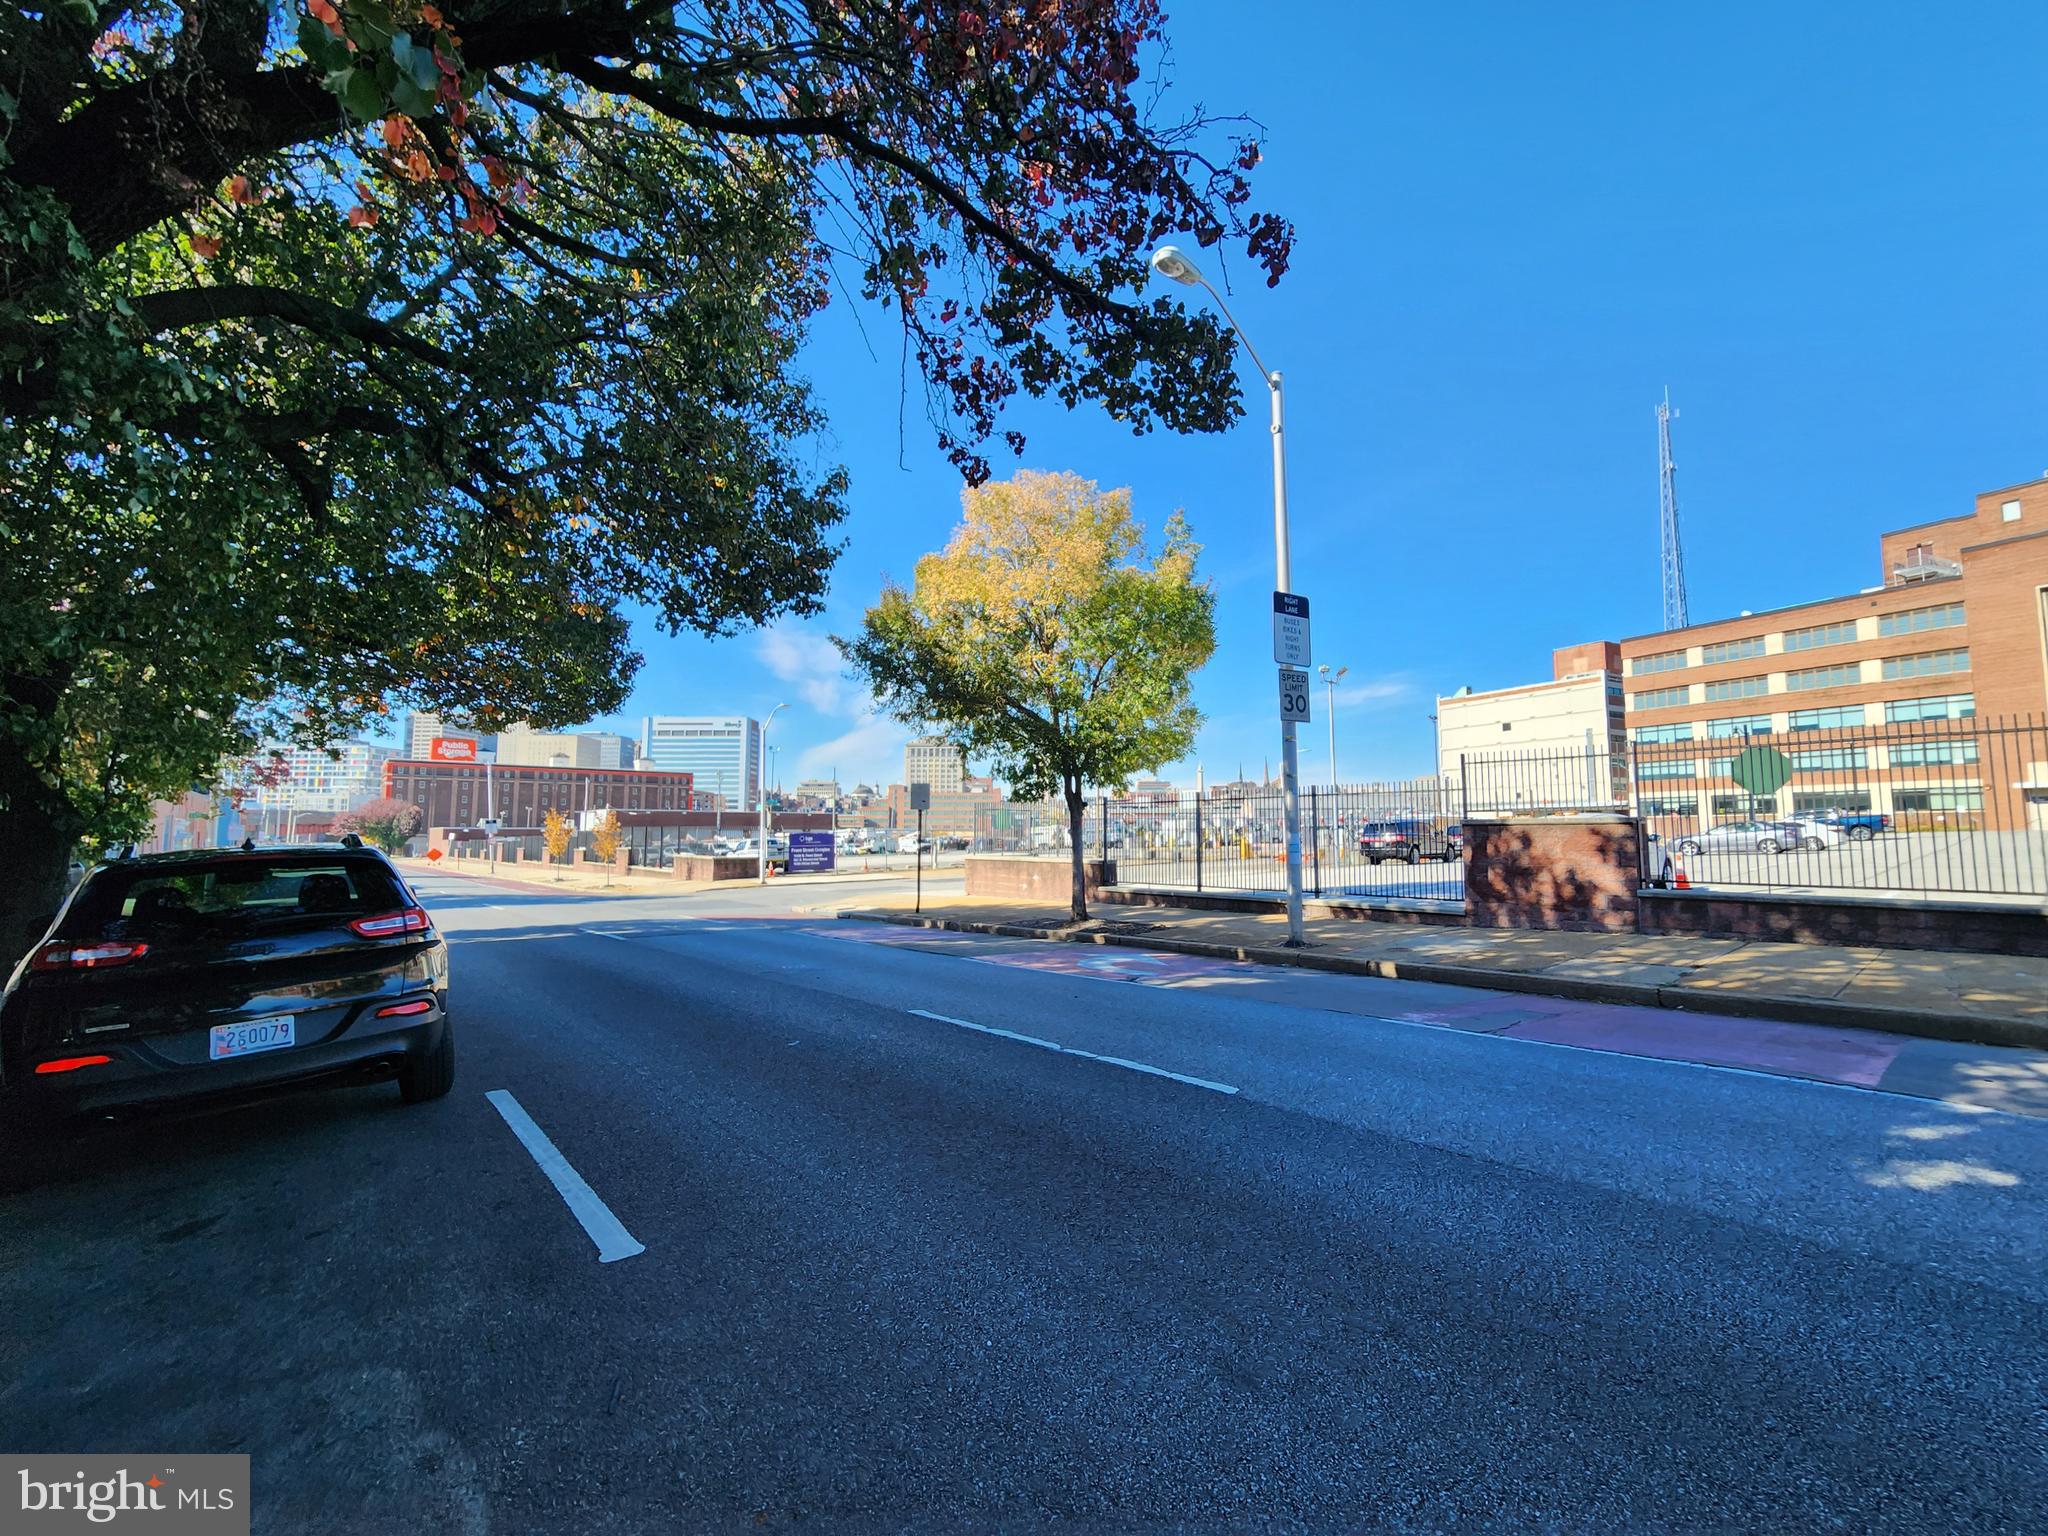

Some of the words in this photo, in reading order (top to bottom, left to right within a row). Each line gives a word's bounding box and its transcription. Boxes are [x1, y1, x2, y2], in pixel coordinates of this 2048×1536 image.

[1284, 596, 1299, 606] RIGHT
[1285, 605, 1298, 614] LANE
[1284, 617, 1300, 626] BUSES
[1283, 625, 1297, 634] BIKES
[1285, 634, 1299, 643] RIGHT
[1285, 643, 1300, 652] TURNS
[1286, 652, 1299, 660] ONLY
[1281, 673, 1306, 683] SPEED
[1284, 683, 1303, 693] LIMIT
[1283, 693, 1306, 713] 30
[442, 741, 469, 750] Public
